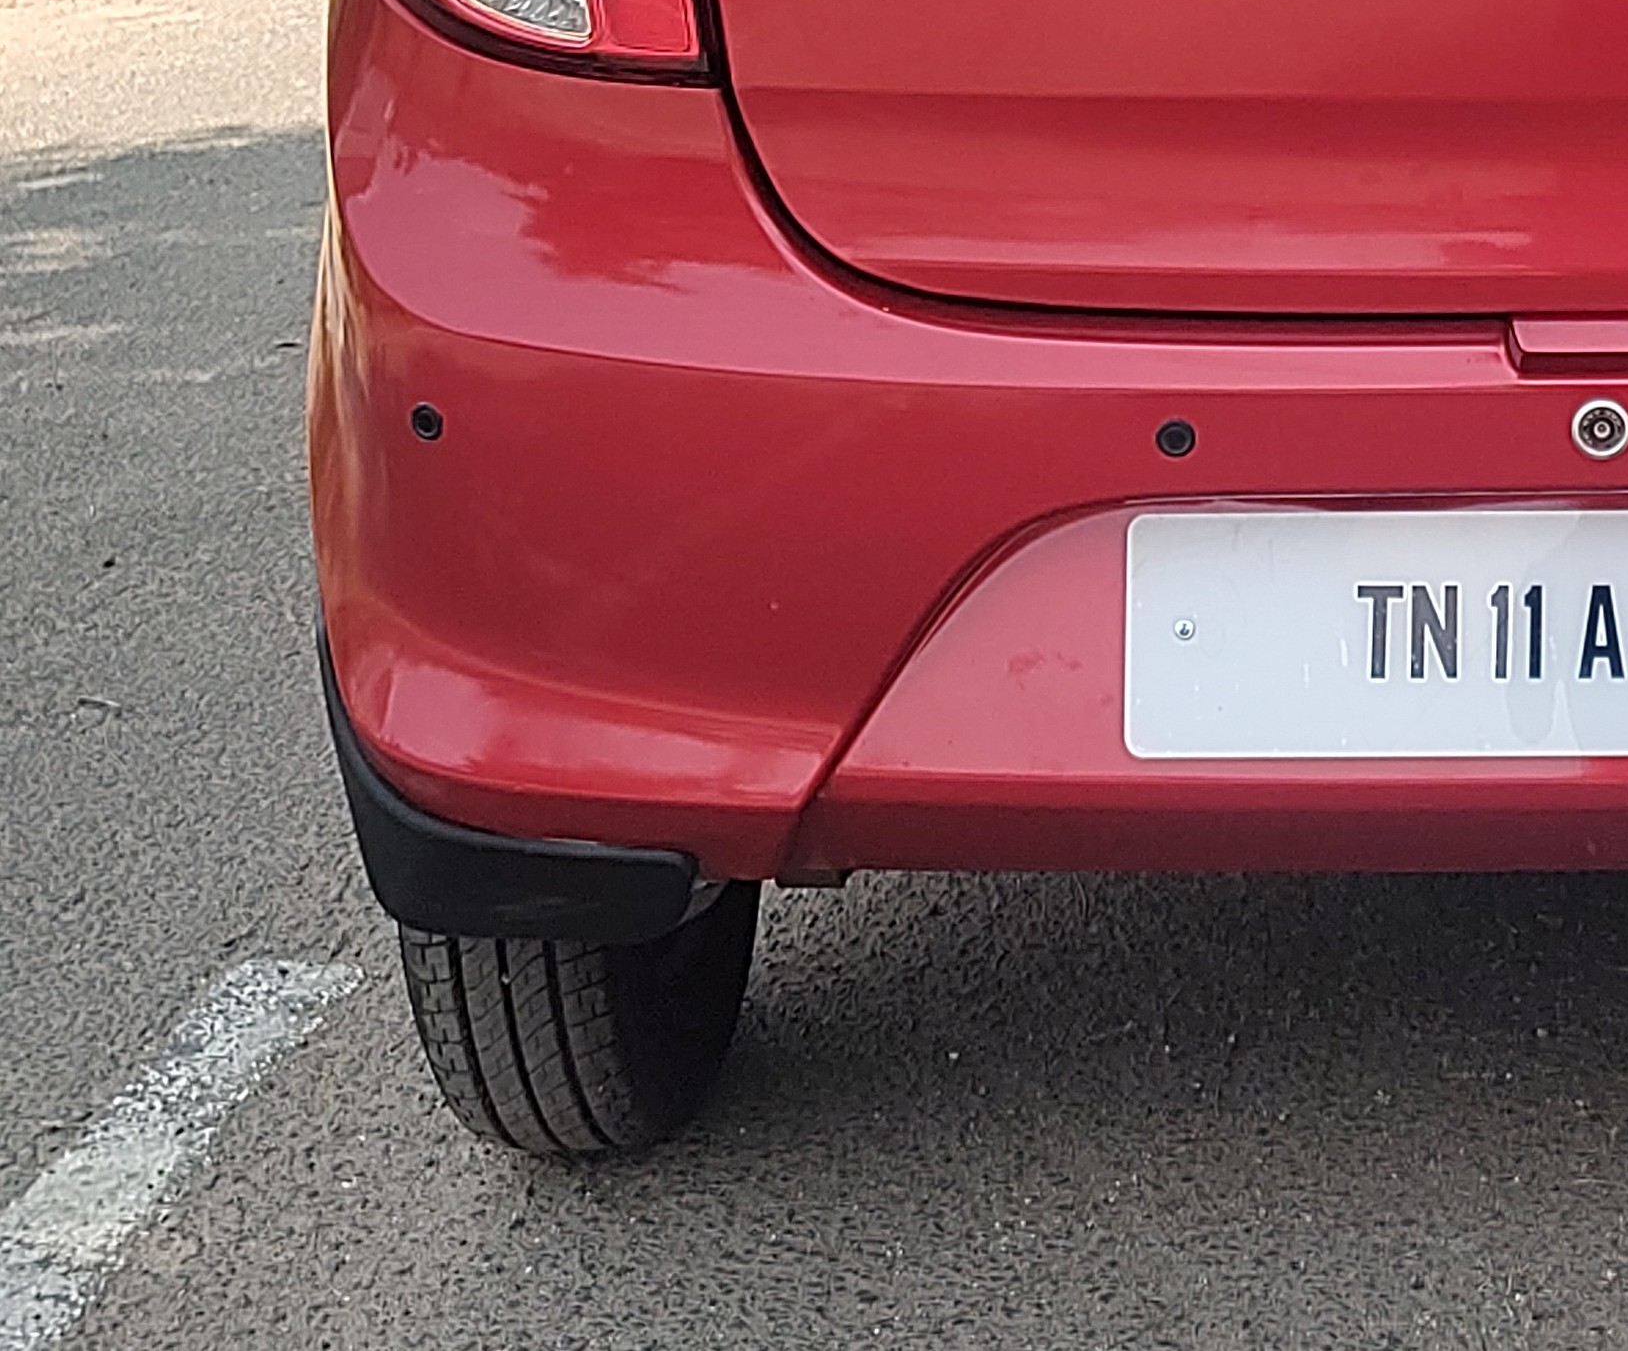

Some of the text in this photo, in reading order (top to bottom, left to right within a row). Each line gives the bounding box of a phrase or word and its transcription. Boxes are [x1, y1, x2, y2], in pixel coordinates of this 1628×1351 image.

[1354, 583, 1460, 680] TN
[1488, 583, 1544, 680] 11
[1577, 583, 1625, 680] A
